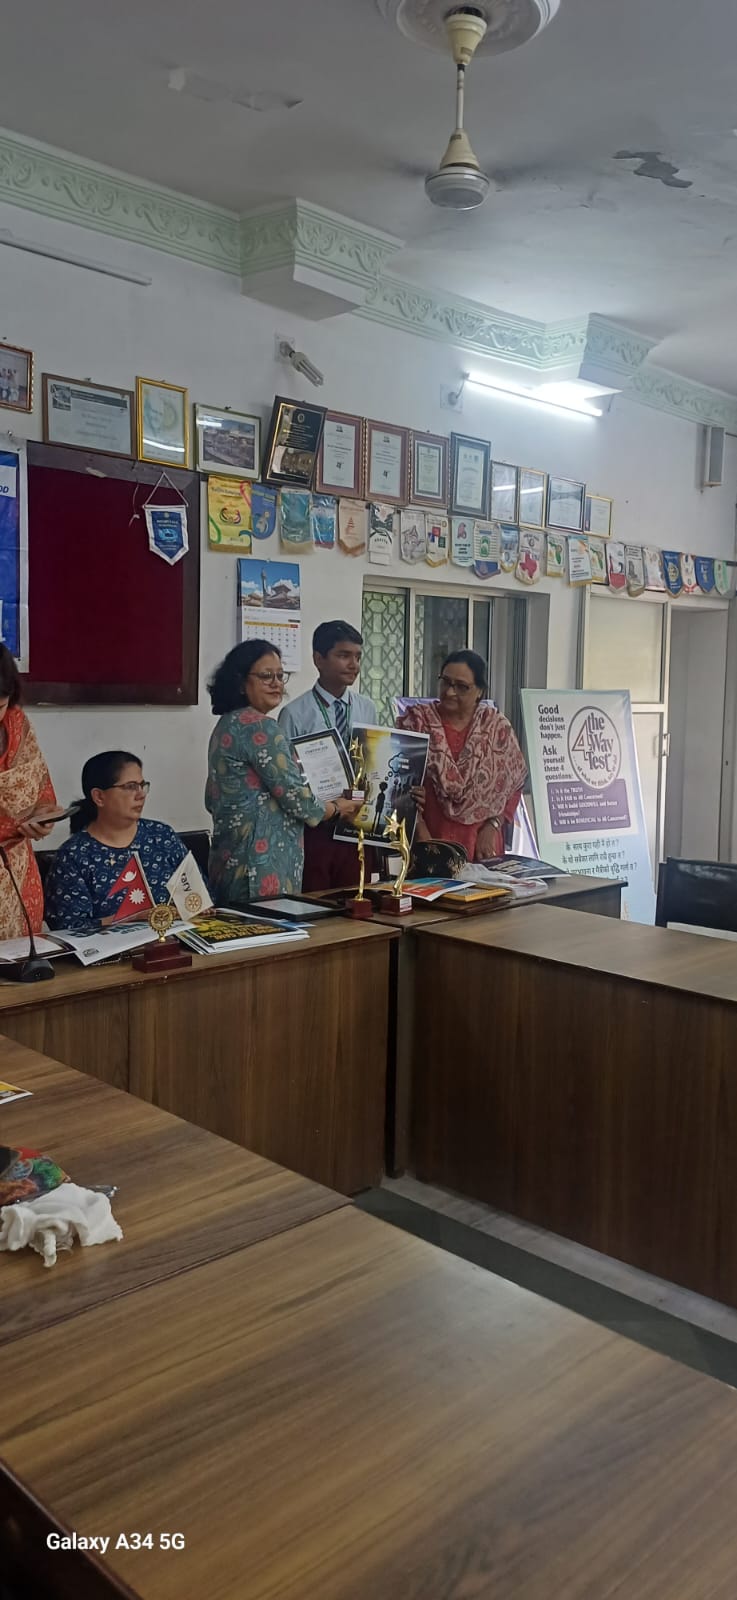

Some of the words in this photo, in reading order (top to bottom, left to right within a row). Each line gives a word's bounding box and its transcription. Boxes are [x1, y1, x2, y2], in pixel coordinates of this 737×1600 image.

[538, 704, 559, 715] Good
[539, 715, 564, 723] decisions
[587, 712, 605, 734] the
[540, 723, 554, 731] don't
[555, 723, 566, 732] just
[541, 731, 563, 740] happen.
[571, 719, 592, 761] 4
[589, 731, 614, 753] Way
[543, 745, 557, 756] Ask
[543, 756, 565, 766] yourself
[586, 751, 611, 772] Test
[545, 772, 573, 781] questions:
